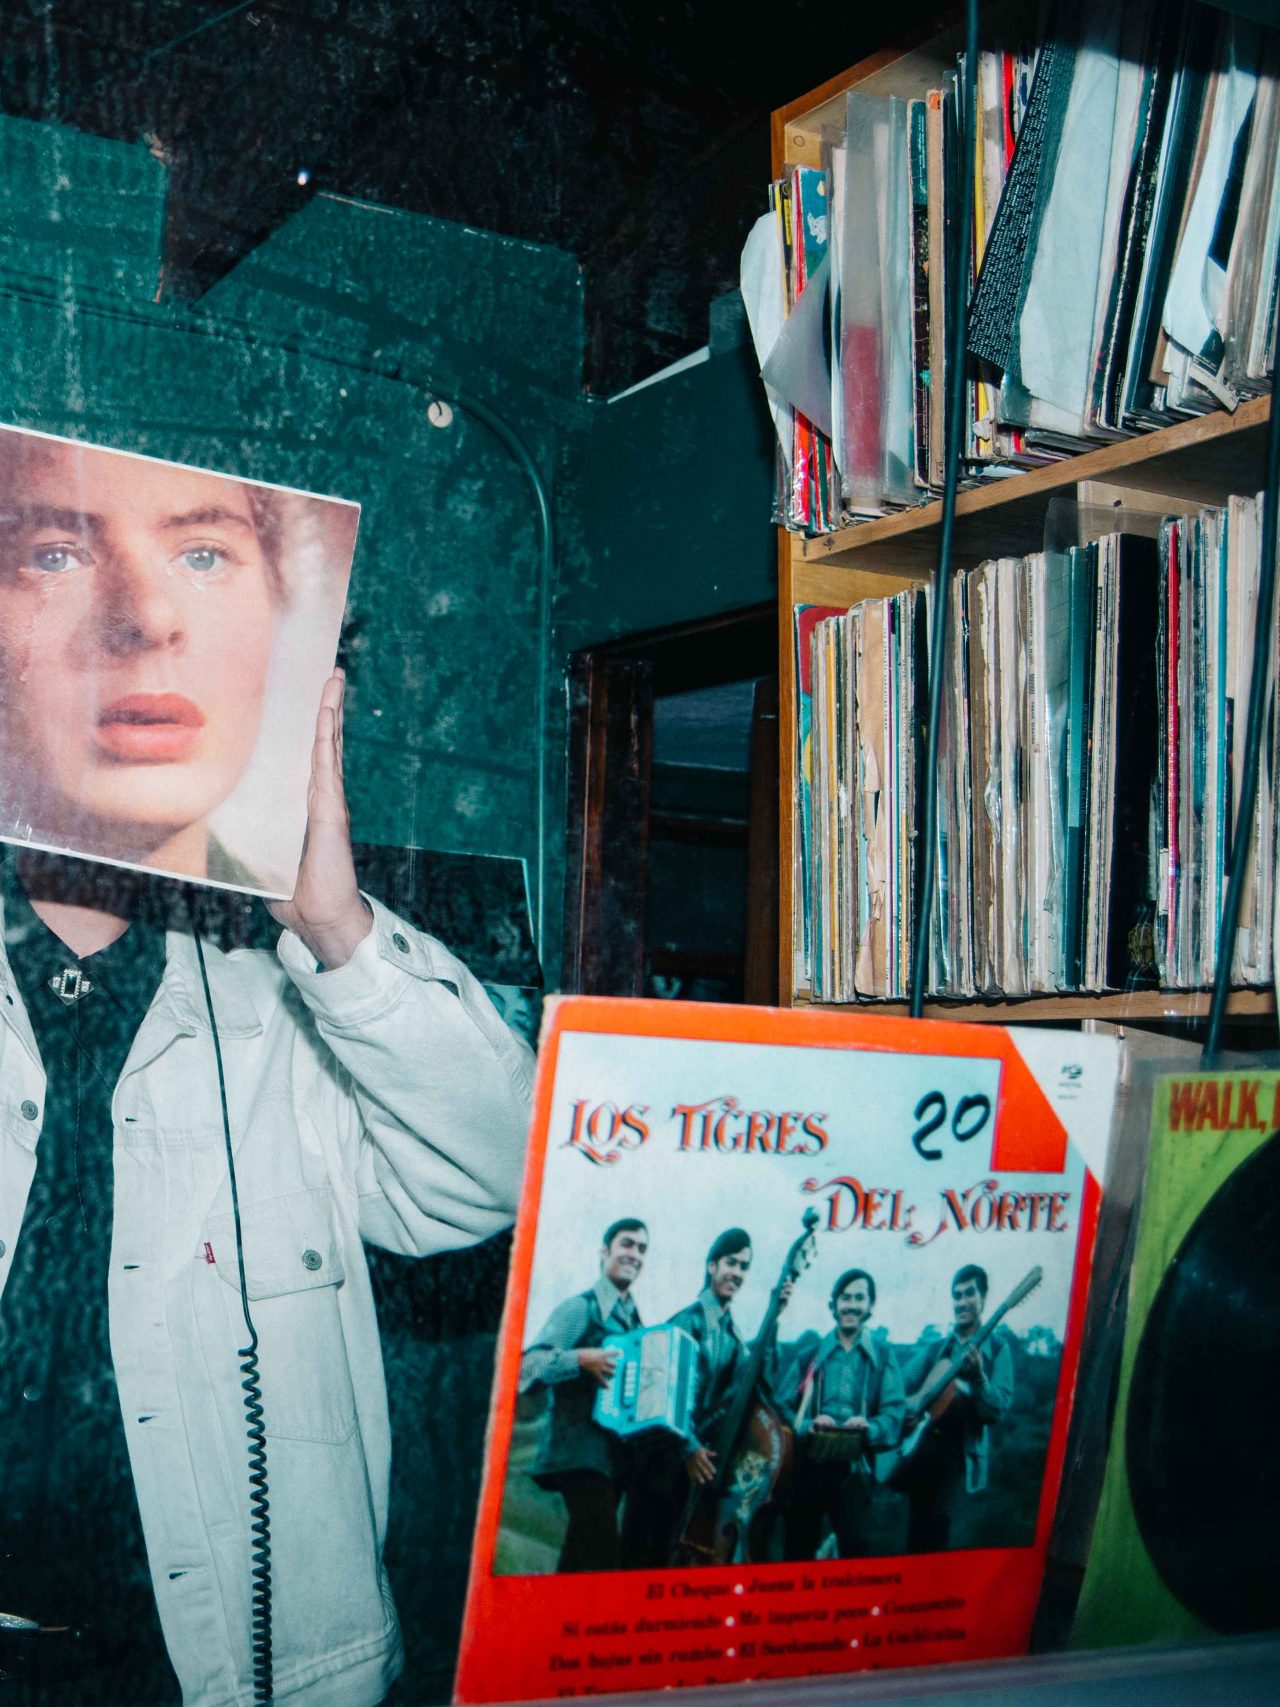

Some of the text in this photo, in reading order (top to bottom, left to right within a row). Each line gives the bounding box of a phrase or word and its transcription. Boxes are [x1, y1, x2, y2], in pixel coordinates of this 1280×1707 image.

[560, 1094, 831, 1166] LOS TIGRES
[912, 1089, 992, 1162] 20
[1168, 1079, 1267, 1136] WALK,
[799, 1175, 1073, 1247] DEL NORTE
[646, 1582, 665, 1599] El
[801, 1572, 815, 1590] la
[634, 1615, 723, 1634] durmiendo
[740, 1610, 761, 1626] Me
[768, 1608, 828, 1626] importa
[549, 1653, 581, 1671] Dos
[639, 1648, 663, 1665] sin
[669, 1645, 724, 1664] rumbo
[739, 1641, 756, 1657] El
